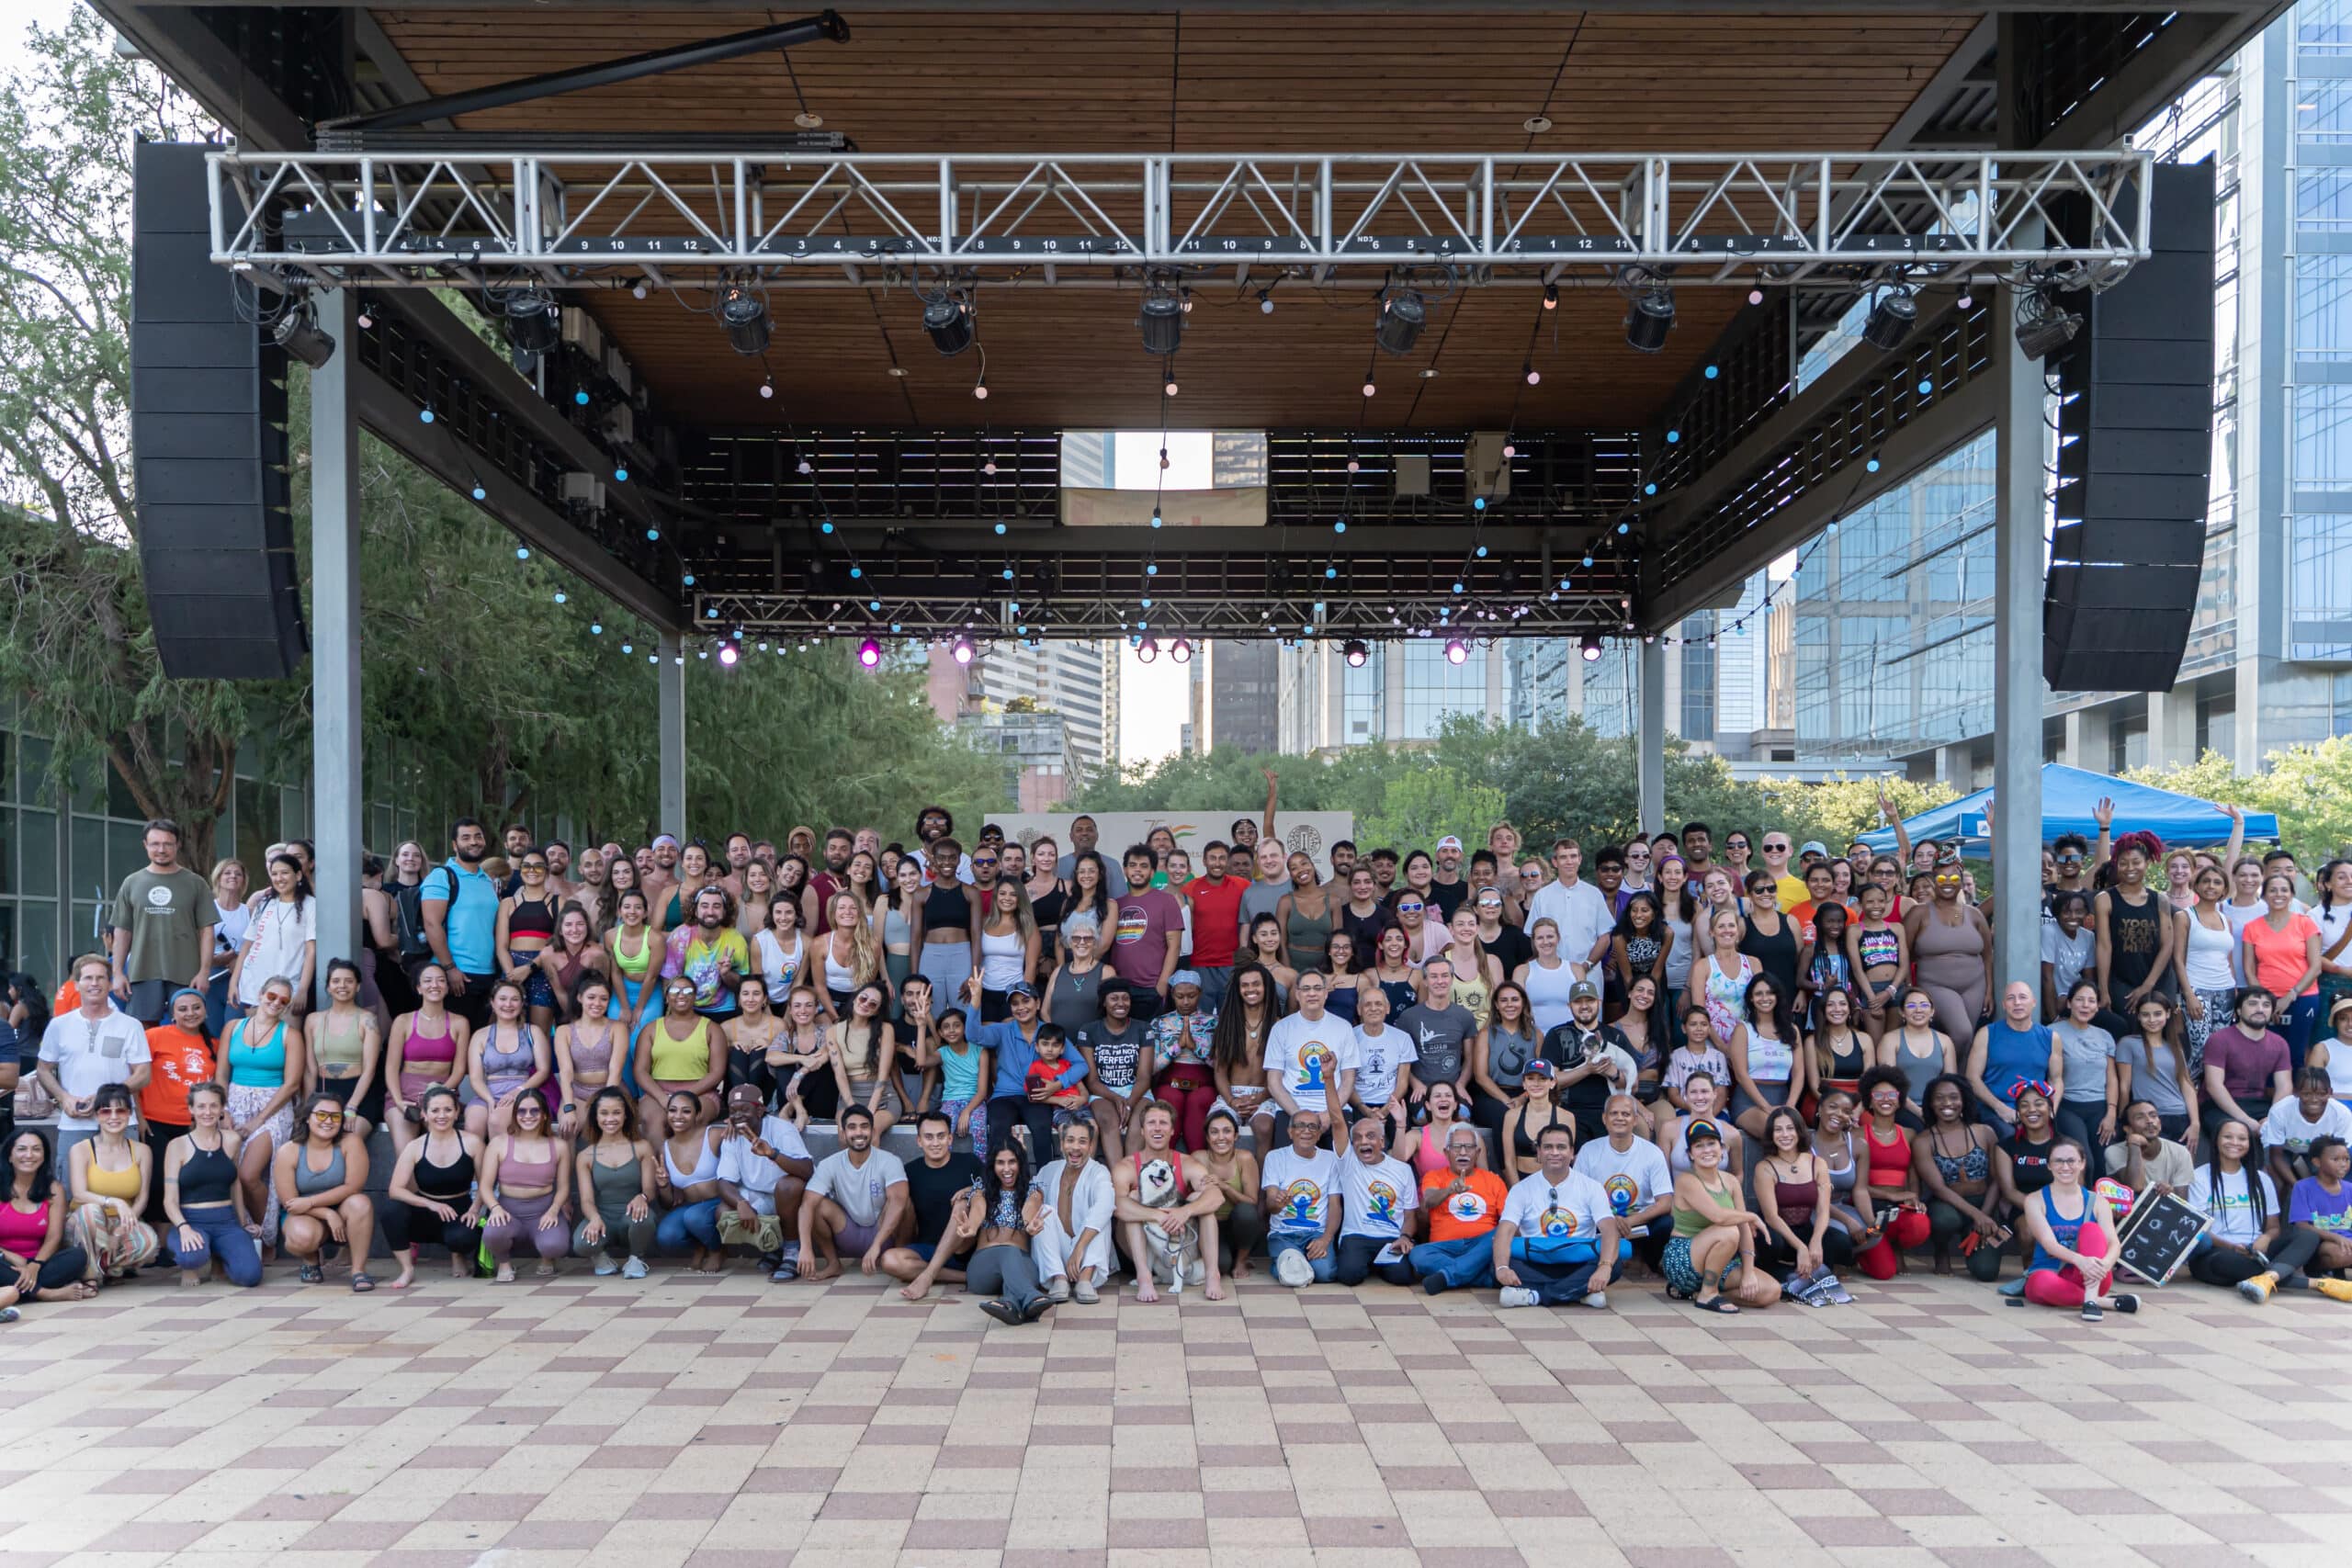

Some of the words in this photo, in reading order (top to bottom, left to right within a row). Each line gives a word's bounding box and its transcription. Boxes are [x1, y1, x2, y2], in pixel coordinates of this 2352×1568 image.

[400, 241, 408, 250] 4
[472, 241, 481, 251] 6
[581, 241, 589, 250] 9
[609, 241, 625, 250] 10
[648, 241, 661, 250] 11
[682, 241, 697, 250] 12
[798, 240, 806, 250] 3
[833, 240, 842, 250] 4
[870, 240, 877, 250] 5
[978, 240, 985, 250] 8
[1013, 240, 1021, 250] 9
[1042, 240, 1057, 250] 10
[1079, 240, 1091, 250] 11
[1186, 240, 1200, 250] 11
[1223, 240, 1237, 250] 10
[1264, 240, 1272, 250] 9
[1372, 240, 1380, 250] 6
[1407, 240, 1414, 249] 5
[1442, 240, 1449, 249] 4
[1513, 240, 1521, 249] 2
[1549, 240, 1556, 249] 1
[1578, 239, 1592, 249] 12
[1614, 239, 1627, 249] 11
[1691, 239, 1699, 248] 9
[1726, 239, 1734, 248] 8
[1762, 239, 1770, 248] 7
[1867, 238, 1875, 247] 4
[1904, 238, 1911, 248] 3
[1939, 238, 1947, 247] 2
[2121, 918, 2156, 927] YOGA
[1863, 933, 1895, 946] HAWAII
[1098, 1055, 1134, 1065] PERFECT
[1098, 1067, 1134, 1077] LIMITED
[2148, 1218, 2163, 1230] 0
